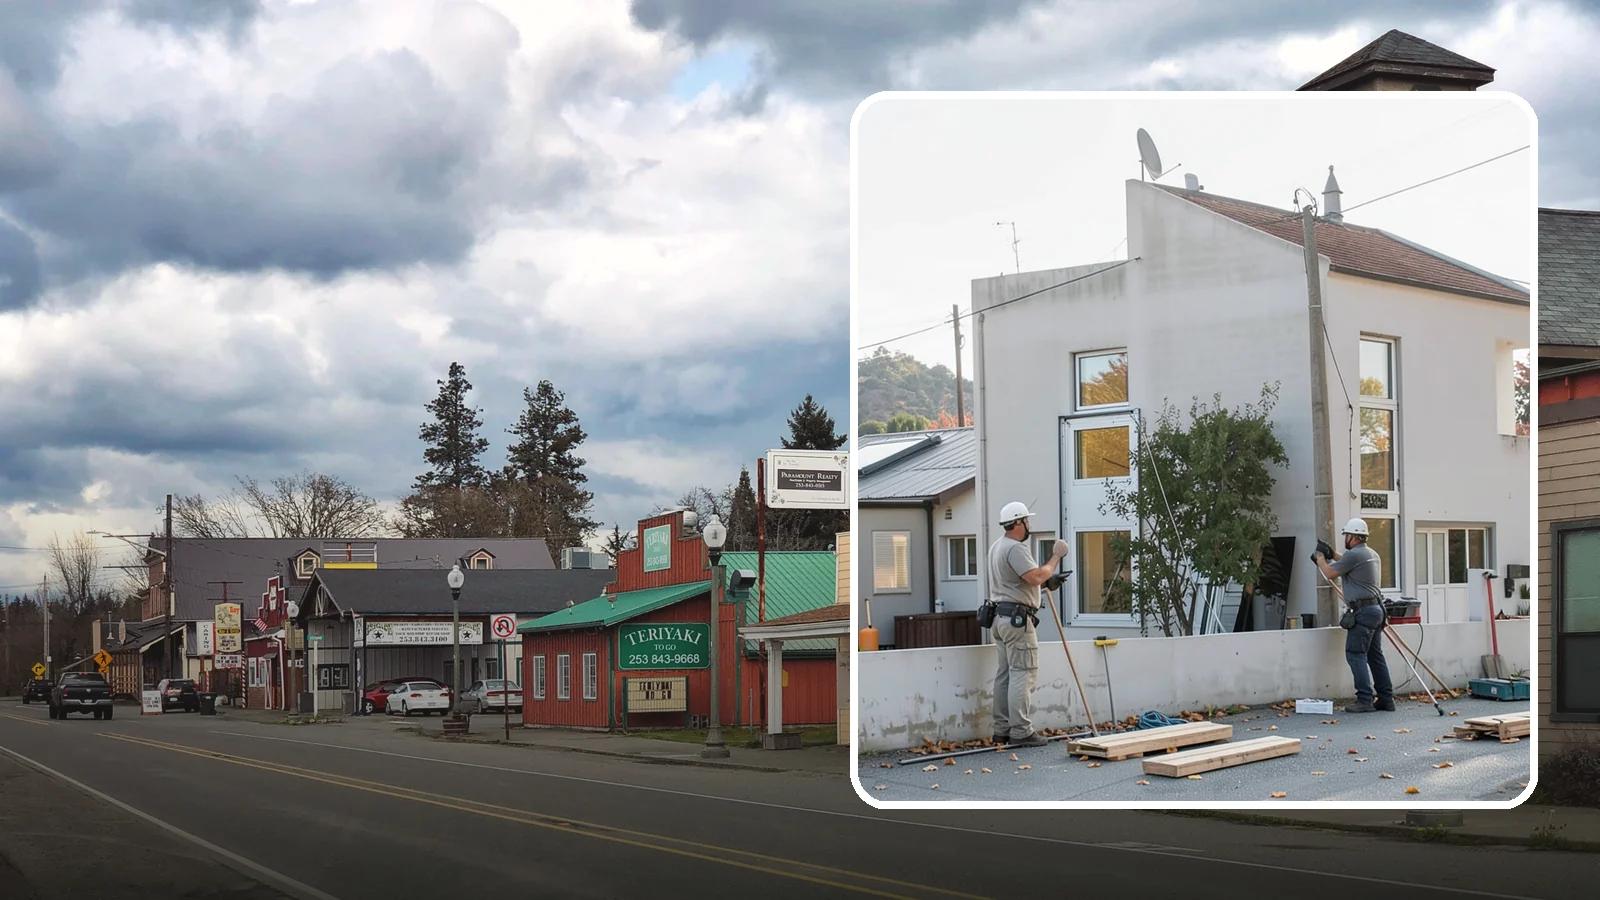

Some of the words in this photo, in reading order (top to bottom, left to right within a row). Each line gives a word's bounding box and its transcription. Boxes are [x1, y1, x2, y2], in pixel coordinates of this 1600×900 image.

[781, 471, 815, 479] PARAMOUNT
[817, 472, 839, 480] REALTY
[624, 627, 702, 646] TERIYAKI
[628, 654, 649, 665] 253
[651, 653, 700, 664] 843-9668
